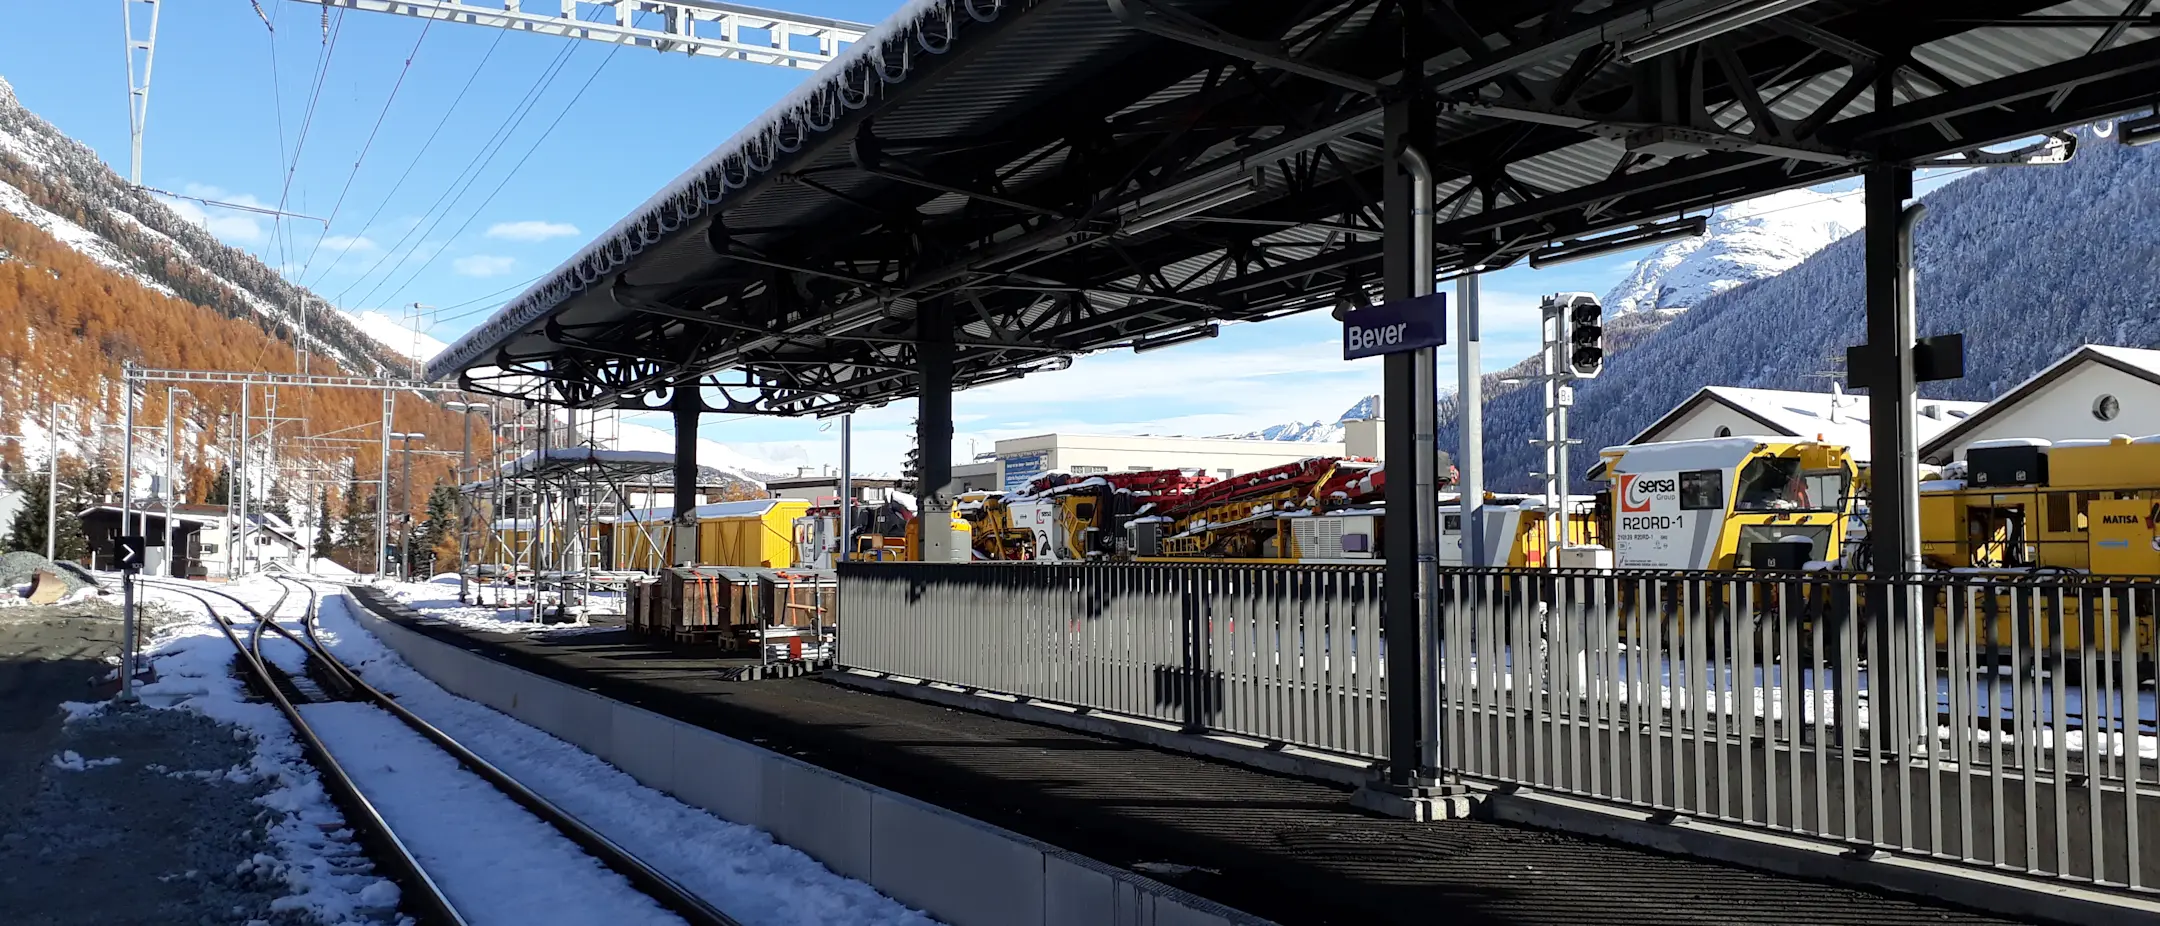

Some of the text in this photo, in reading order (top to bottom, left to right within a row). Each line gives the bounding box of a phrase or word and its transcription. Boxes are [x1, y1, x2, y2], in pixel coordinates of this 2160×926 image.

[1348, 322, 1407, 351] Bever
[1638, 479, 1675, 494] sersa
[1656, 493, 1676, 501] Group
[2102, 515, 2139, 524] MATISA
